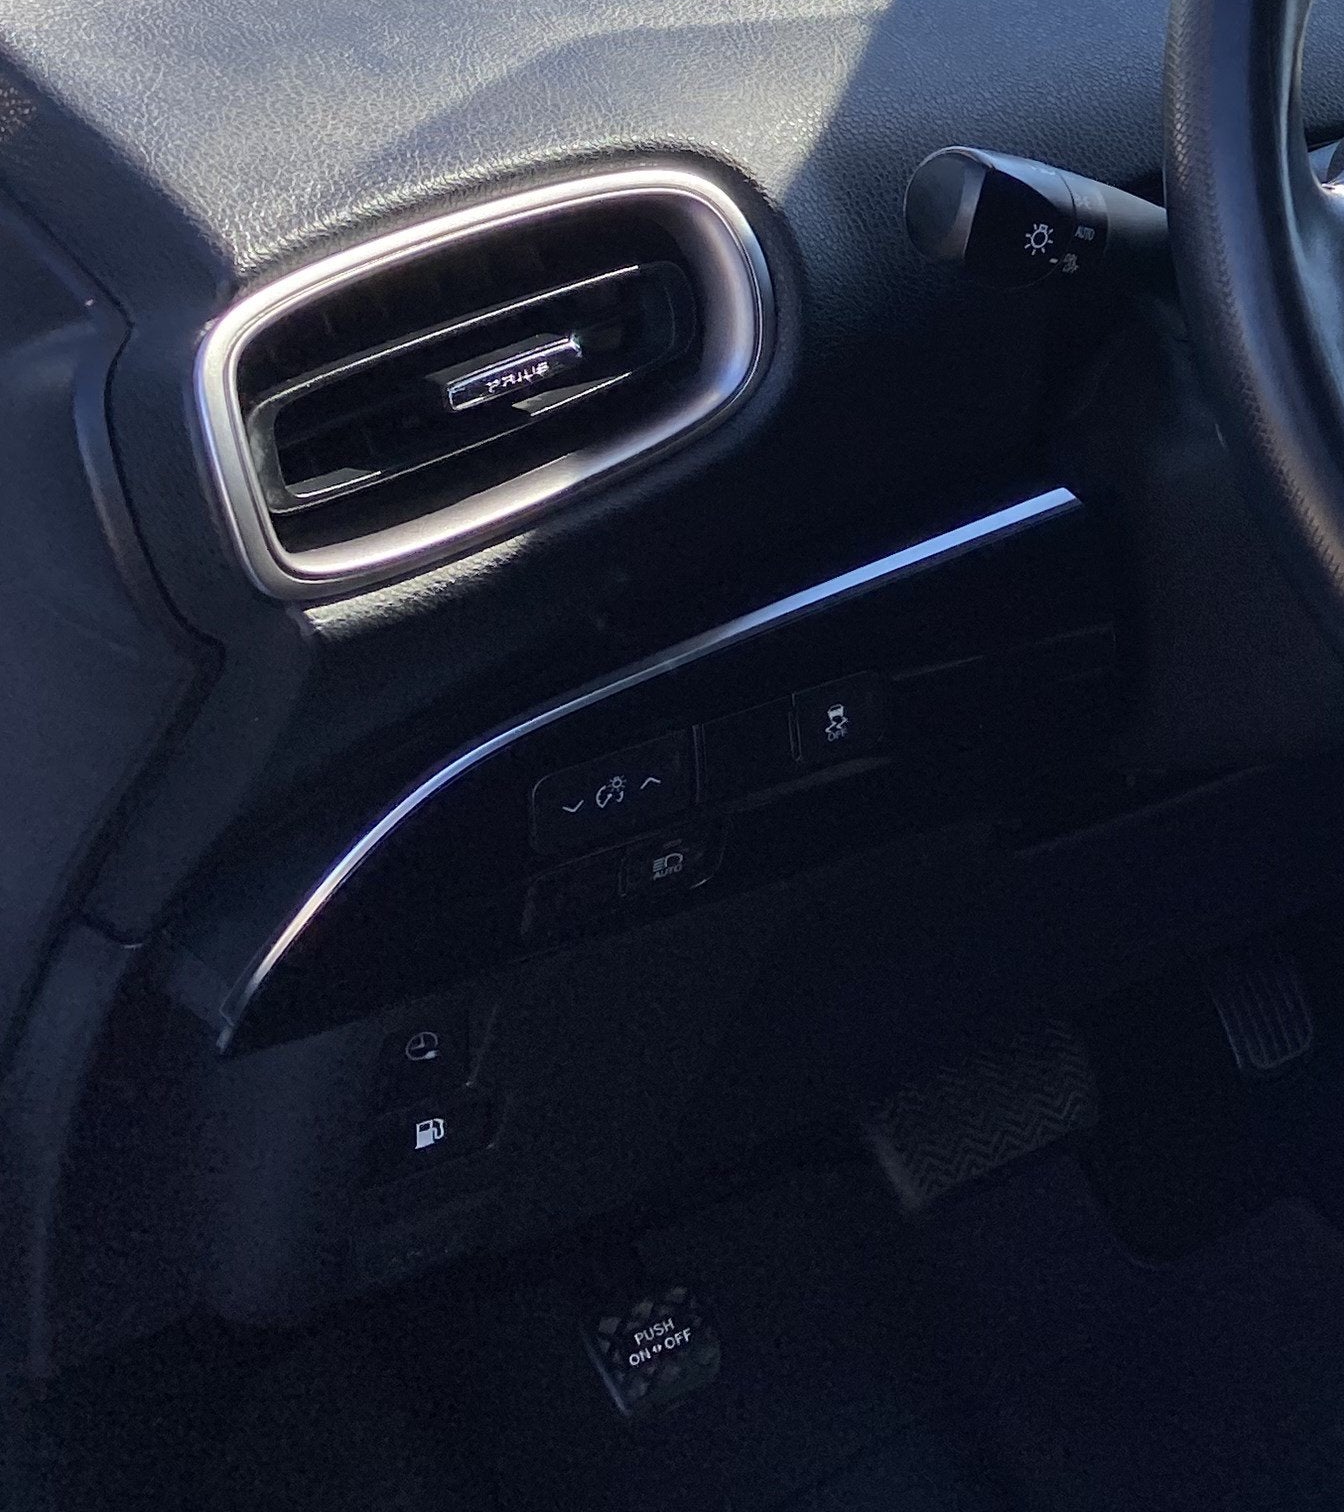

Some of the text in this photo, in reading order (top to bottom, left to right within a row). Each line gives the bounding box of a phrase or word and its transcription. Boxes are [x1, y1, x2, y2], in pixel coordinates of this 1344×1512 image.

[629, 1327, 692, 1366] ON OFF
[634, 1318, 675, 1346] PUSH
